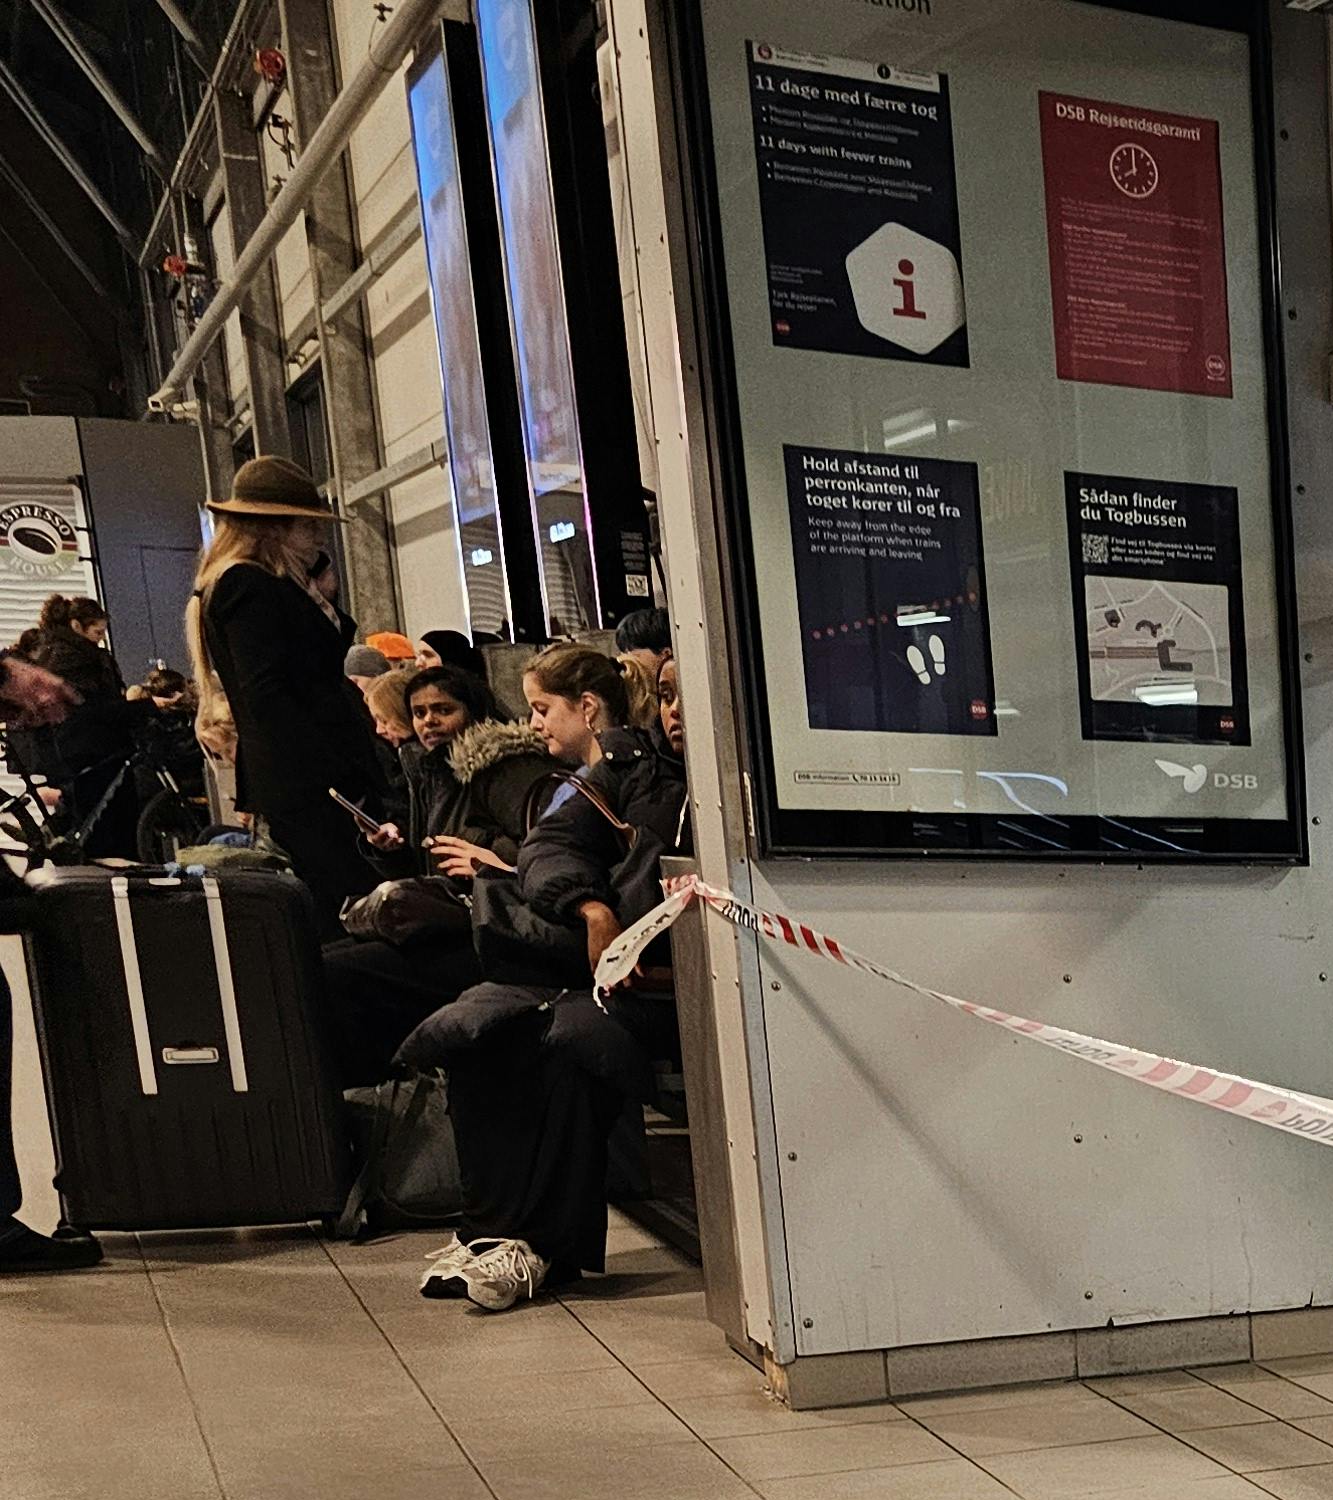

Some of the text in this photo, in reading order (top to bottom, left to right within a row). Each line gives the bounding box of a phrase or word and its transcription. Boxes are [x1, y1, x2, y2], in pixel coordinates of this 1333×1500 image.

[754, 74, 938, 121] 11 dage med færre tog
[1056, 102, 1085, 121] DSB
[759, 134, 775, 148] 11
[778, 138, 807, 154] days
[809, 143, 839, 158] with
[878, 155, 912, 170] trains
[803, 456, 919, 480] Hold afstand til
[804, 476, 941, 498] perronkanten, når
[806, 493, 961, 519] toget kører til og fra
[1080, 488, 1177, 511] Sådan finder
[0, 506, 71, 536] ESPRESSO
[808, 516, 932, 536] Keep away from the edge
[1080, 505, 1187, 528] du Togbussen
[809, 530, 942, 549] of the platform when trains
[1111, 536, 1126, 545] Find
[1148, 540, 1182, 550] Togbussen
[810, 544, 923, 561] are arriving and leaving
[1214, 773, 1258, 789] DSB
